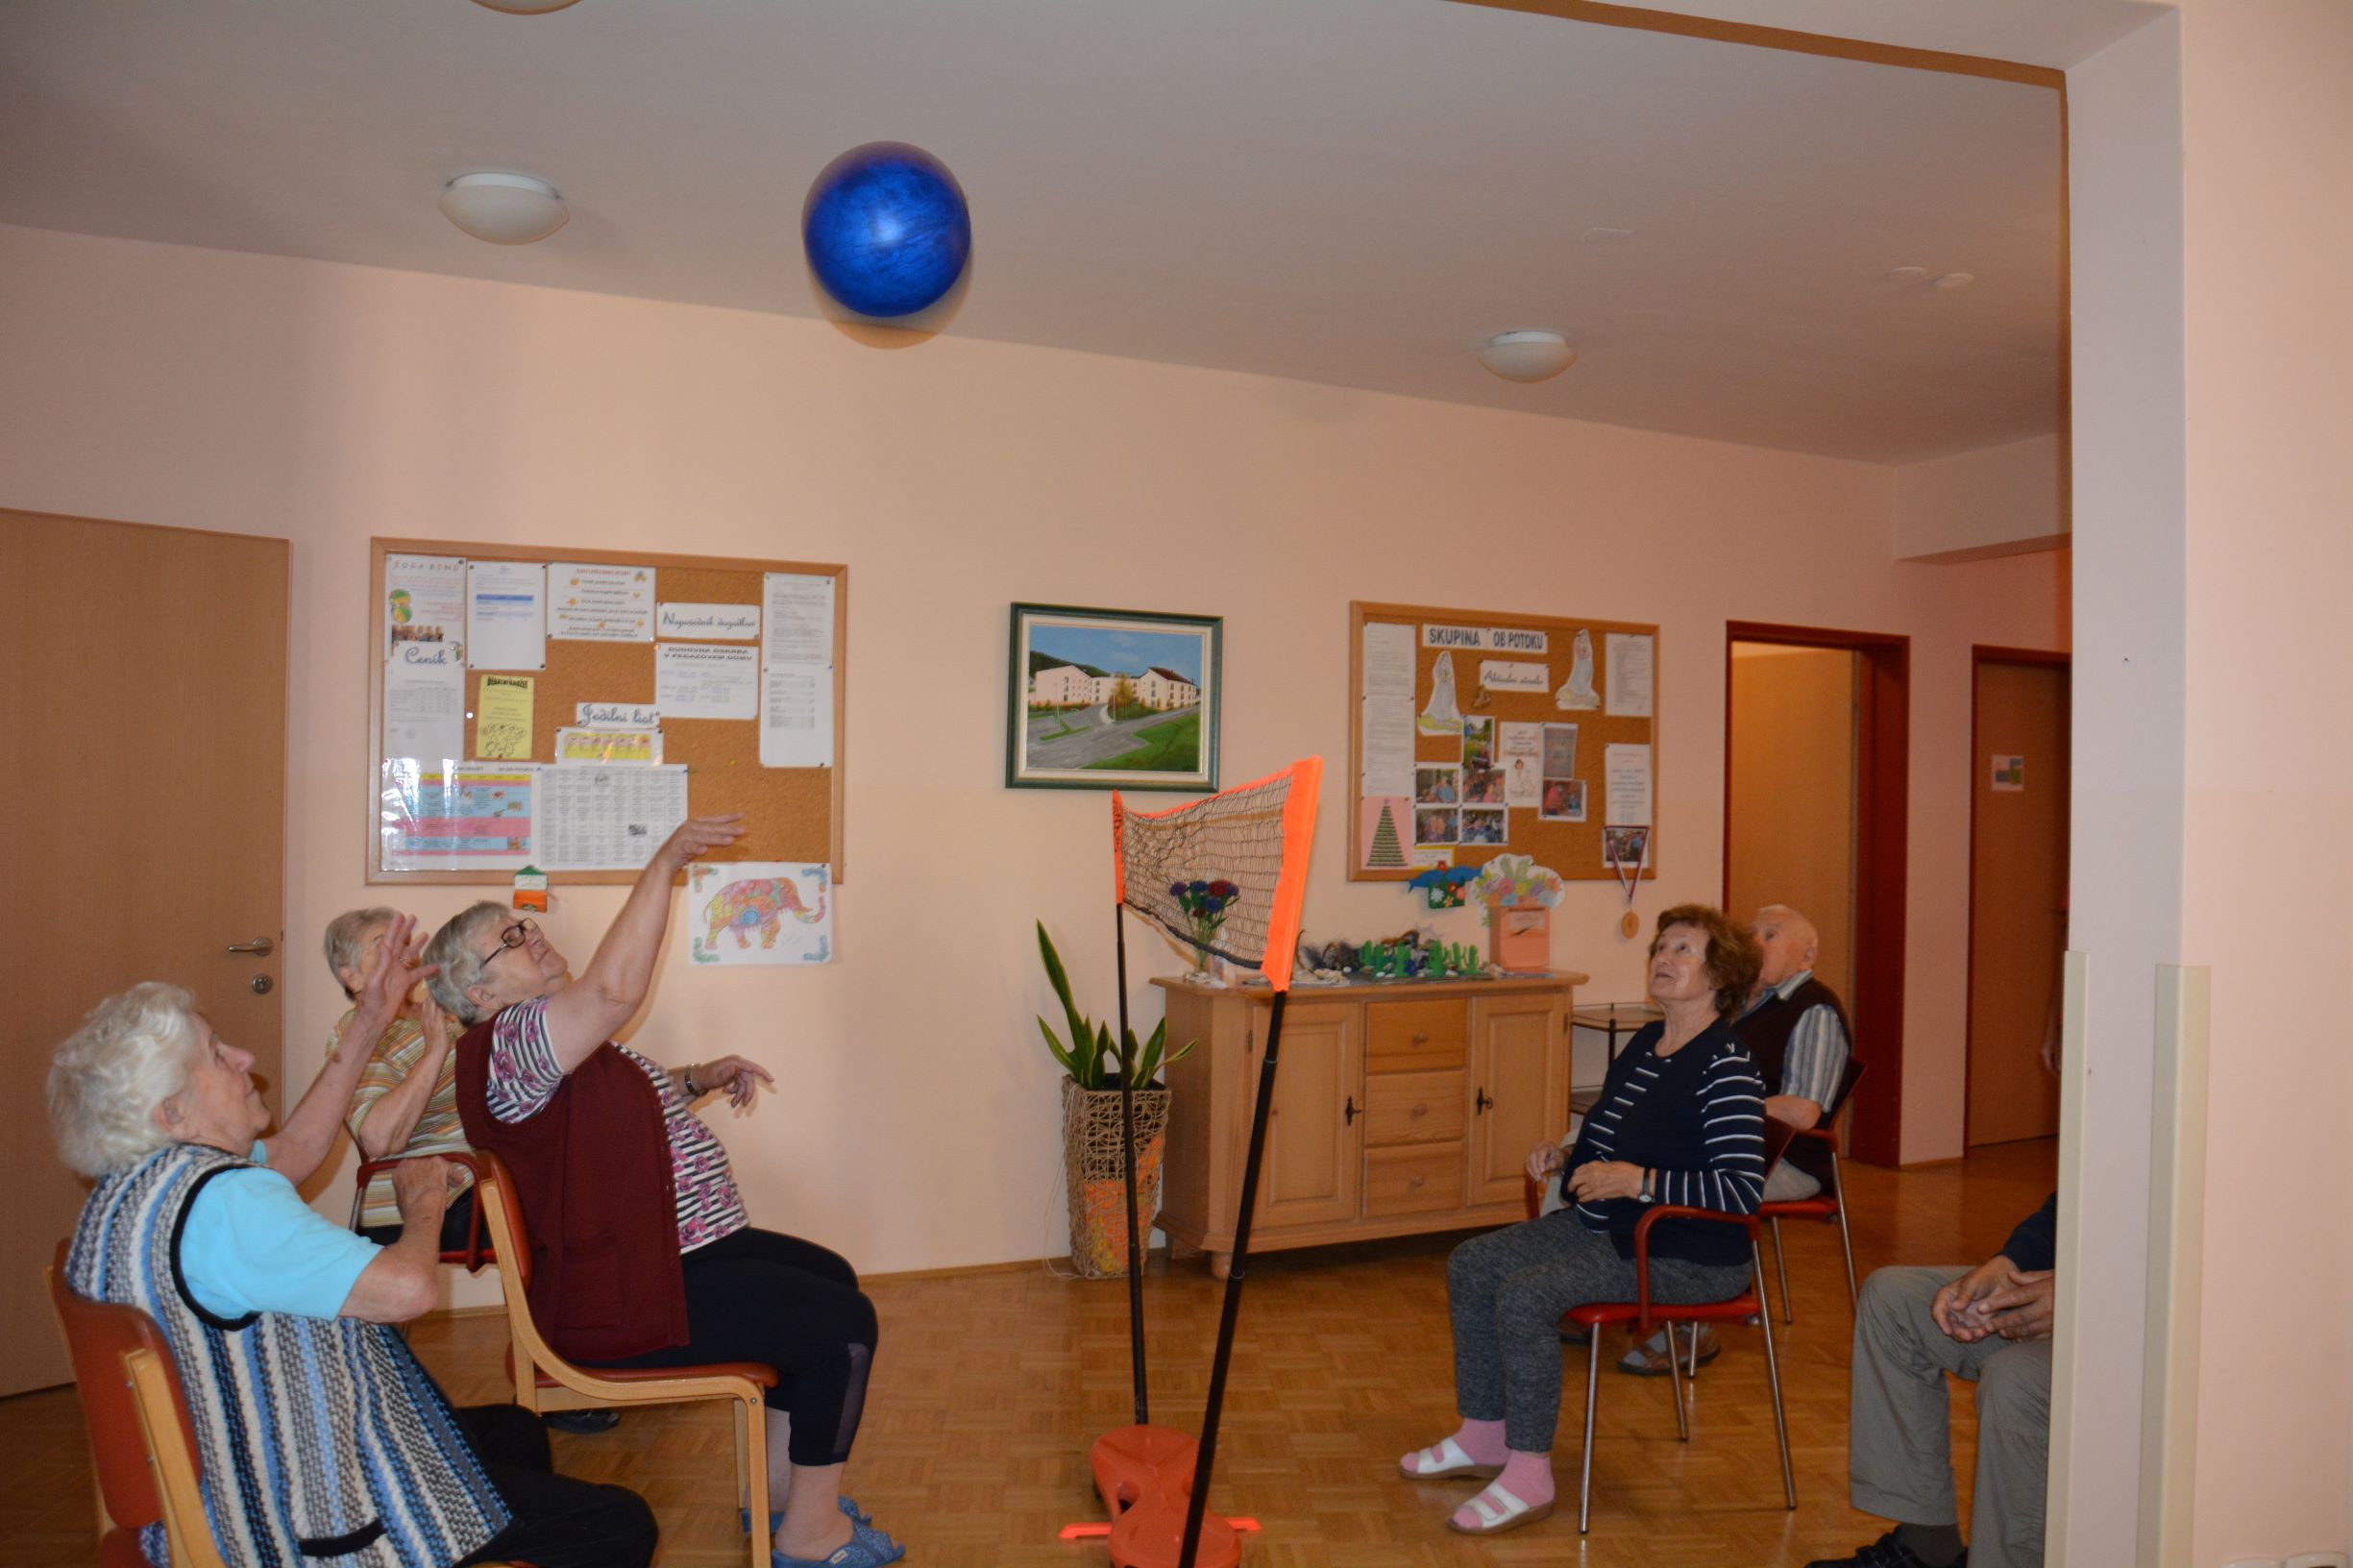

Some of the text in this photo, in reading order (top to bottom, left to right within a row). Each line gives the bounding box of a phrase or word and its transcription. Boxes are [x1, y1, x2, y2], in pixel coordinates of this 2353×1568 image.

[1429, 626, 1544, 649] SKUPINA OB POTOKU
[405, 647, 447, 664] Cenik
[578, 703, 655, 727] Jedilni list
